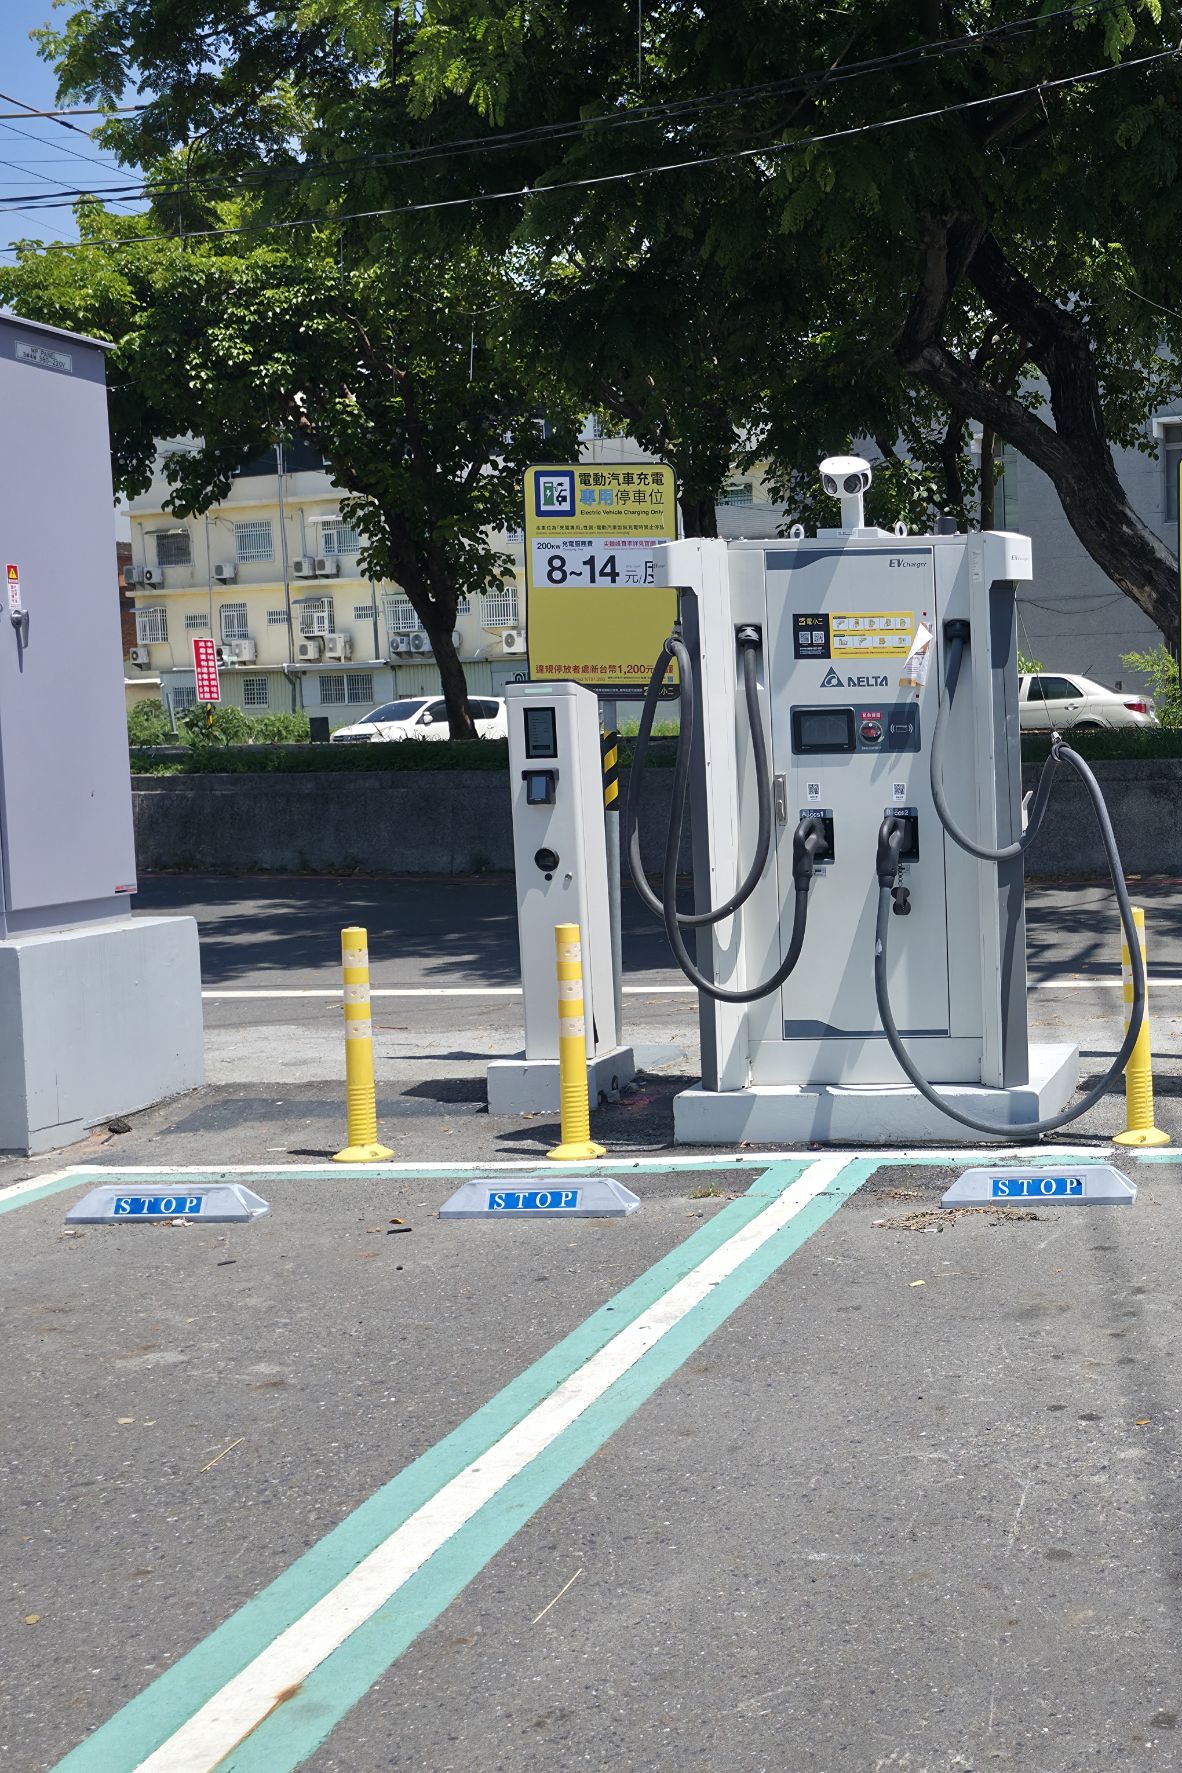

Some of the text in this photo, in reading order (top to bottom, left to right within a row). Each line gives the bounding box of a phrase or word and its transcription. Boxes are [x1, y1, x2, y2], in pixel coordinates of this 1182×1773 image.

[578, 472, 664, 486] 電動汽車充電
[580, 489, 664, 506] 專用停車位
[536, 542, 561, 550] 200KW
[546, 554, 620, 585] 8~14
[536, 664, 674, 675] 違規停放者處新台幣1,200元鍰
[848, 676, 888, 688] DELTA
[998, 1178, 1077, 1196] STOP
[119, 1198, 197, 1214] STOP
[494, 1191, 572, 1210] STOP
